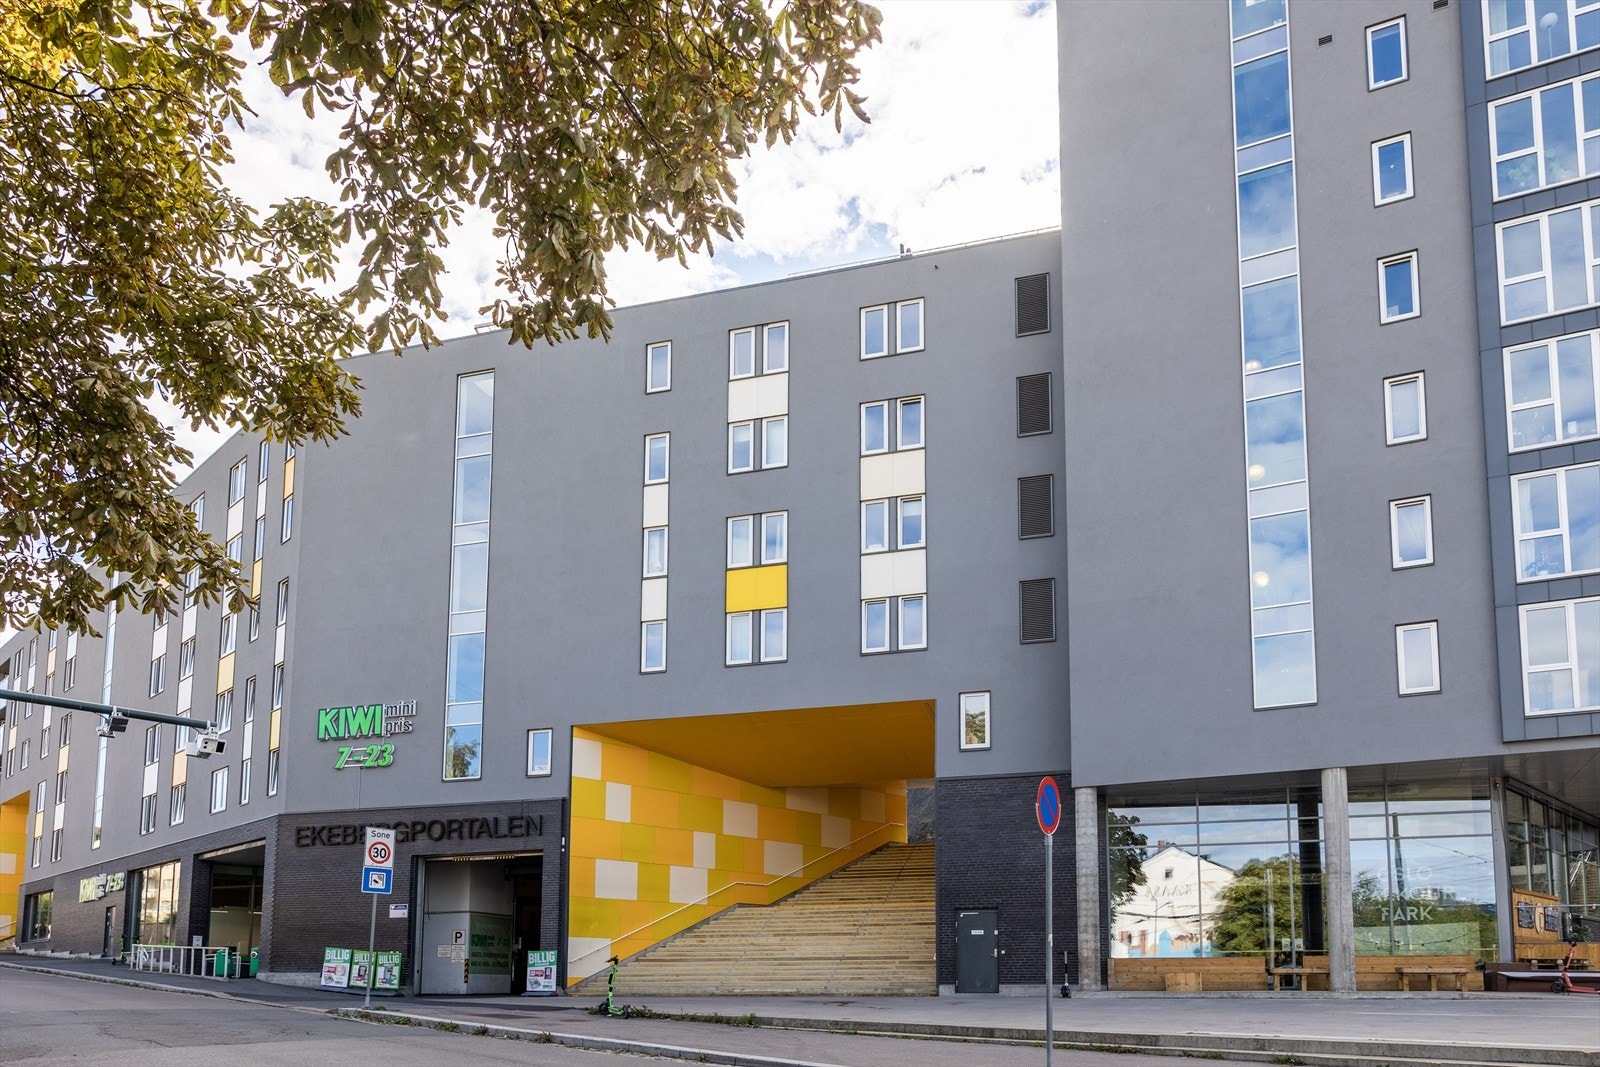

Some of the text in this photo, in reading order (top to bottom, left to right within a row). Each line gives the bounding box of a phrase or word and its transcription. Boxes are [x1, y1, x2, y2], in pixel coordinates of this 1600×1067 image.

[318, 700, 416, 740] KIWI mini
[385, 718, 413, 737] pris
[335, 743, 394, 769] 7-23
[295, 815, 542, 847] EKEBEGPORTALEN
[371, 830, 391, 839] Sone
[372, 847, 387, 859] 30
[1381, 905, 1433, 921] PARK
[455, 932, 462, 943] P
[326, 949, 350, 960] BILLIG
[378, 955, 400, 964] BILLIG
[529, 952, 555, 964] BILLIG
